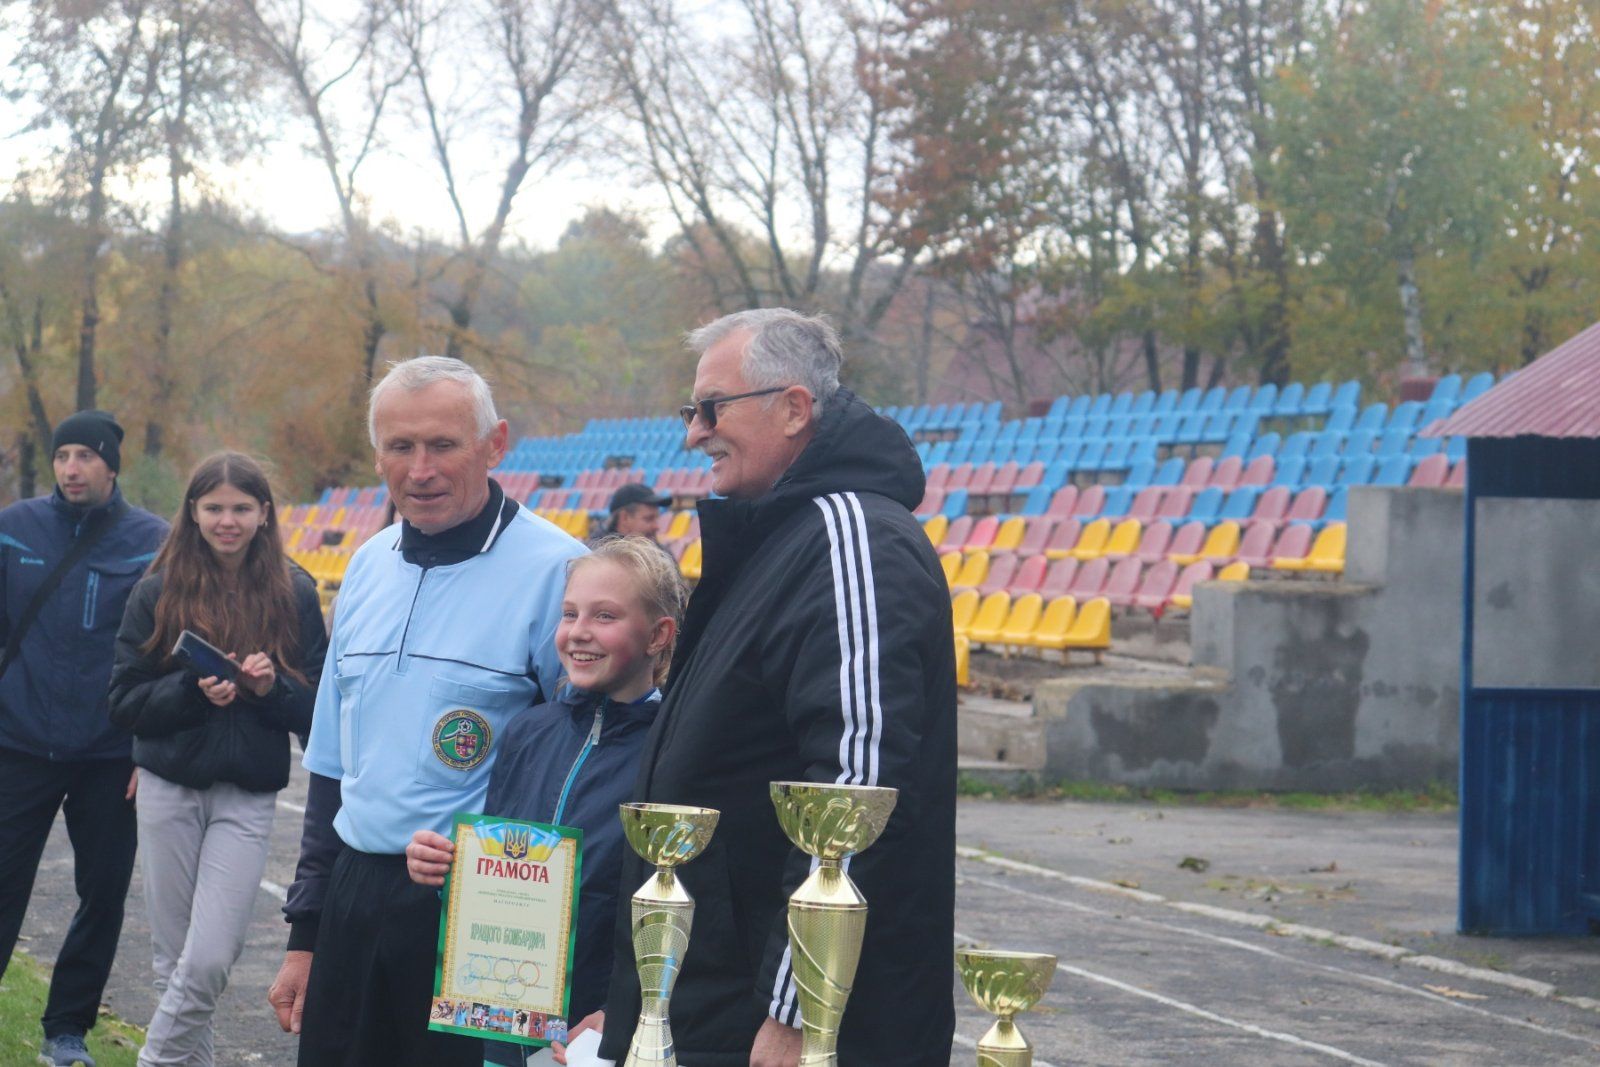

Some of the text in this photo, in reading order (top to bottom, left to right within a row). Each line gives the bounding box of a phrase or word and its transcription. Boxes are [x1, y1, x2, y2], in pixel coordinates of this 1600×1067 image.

[476, 858, 549, 883] ГРАМОТА
[470, 922, 546, 951] КРАЩОГО БОМБАРДИРА
